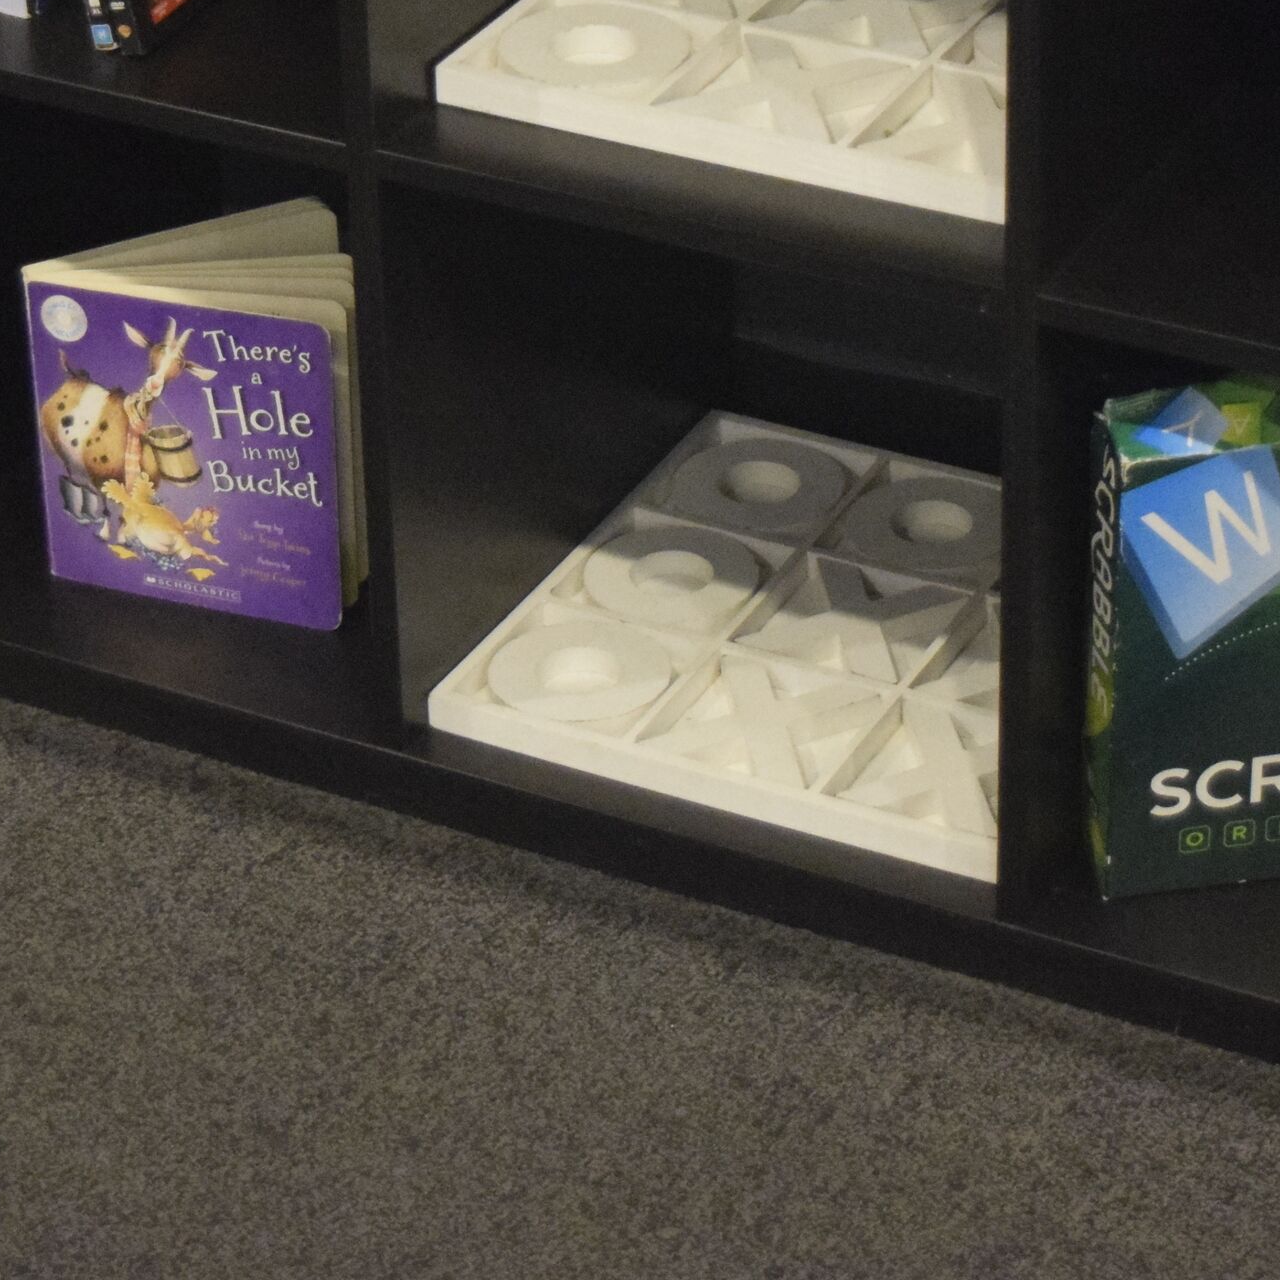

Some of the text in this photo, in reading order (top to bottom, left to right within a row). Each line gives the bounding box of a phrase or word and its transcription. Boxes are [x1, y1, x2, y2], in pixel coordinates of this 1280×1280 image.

[202, 330, 312, 374] There's
[251, 372, 263, 386] a
[201, 385, 314, 440] Hole
[241, 441, 300, 471] in my
[206, 459, 323, 507] Bucket
[158, 577, 239, 601] SCHOLASTIC
[1091, 445, 1116, 712] SCRABBLE
